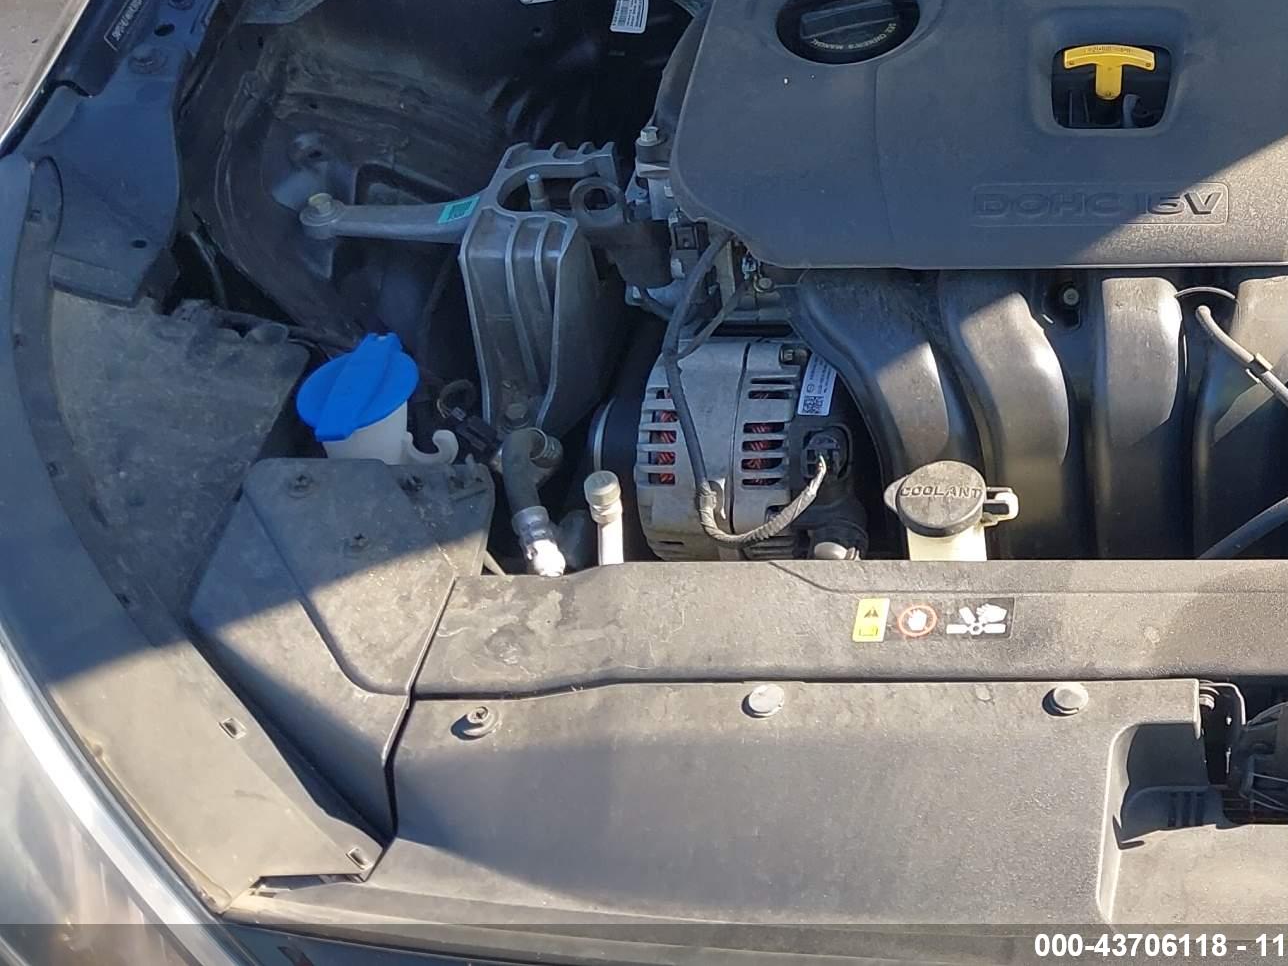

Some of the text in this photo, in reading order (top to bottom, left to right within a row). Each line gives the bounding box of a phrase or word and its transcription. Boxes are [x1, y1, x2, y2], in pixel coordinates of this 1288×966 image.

[974, 191, 1224, 218] DOHC 16V
[900, 485, 982, 499] COOLANT
